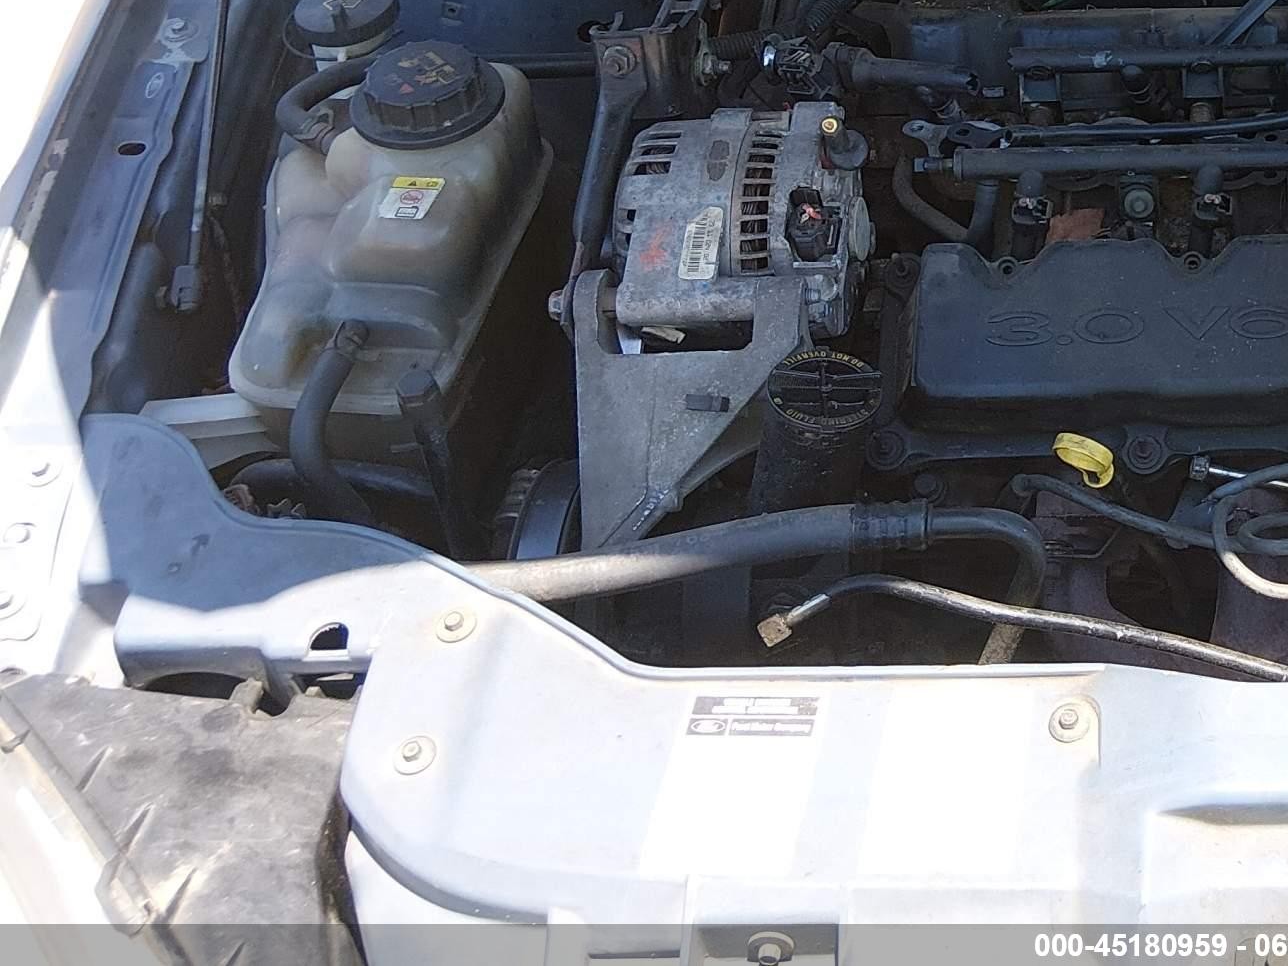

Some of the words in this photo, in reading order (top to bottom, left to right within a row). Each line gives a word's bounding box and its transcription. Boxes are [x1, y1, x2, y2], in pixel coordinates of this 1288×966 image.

[985, 308, 1145, 346] 3.0
[783, 350, 826, 366] OVERFILL
[831, 351, 849, 362] NOT
